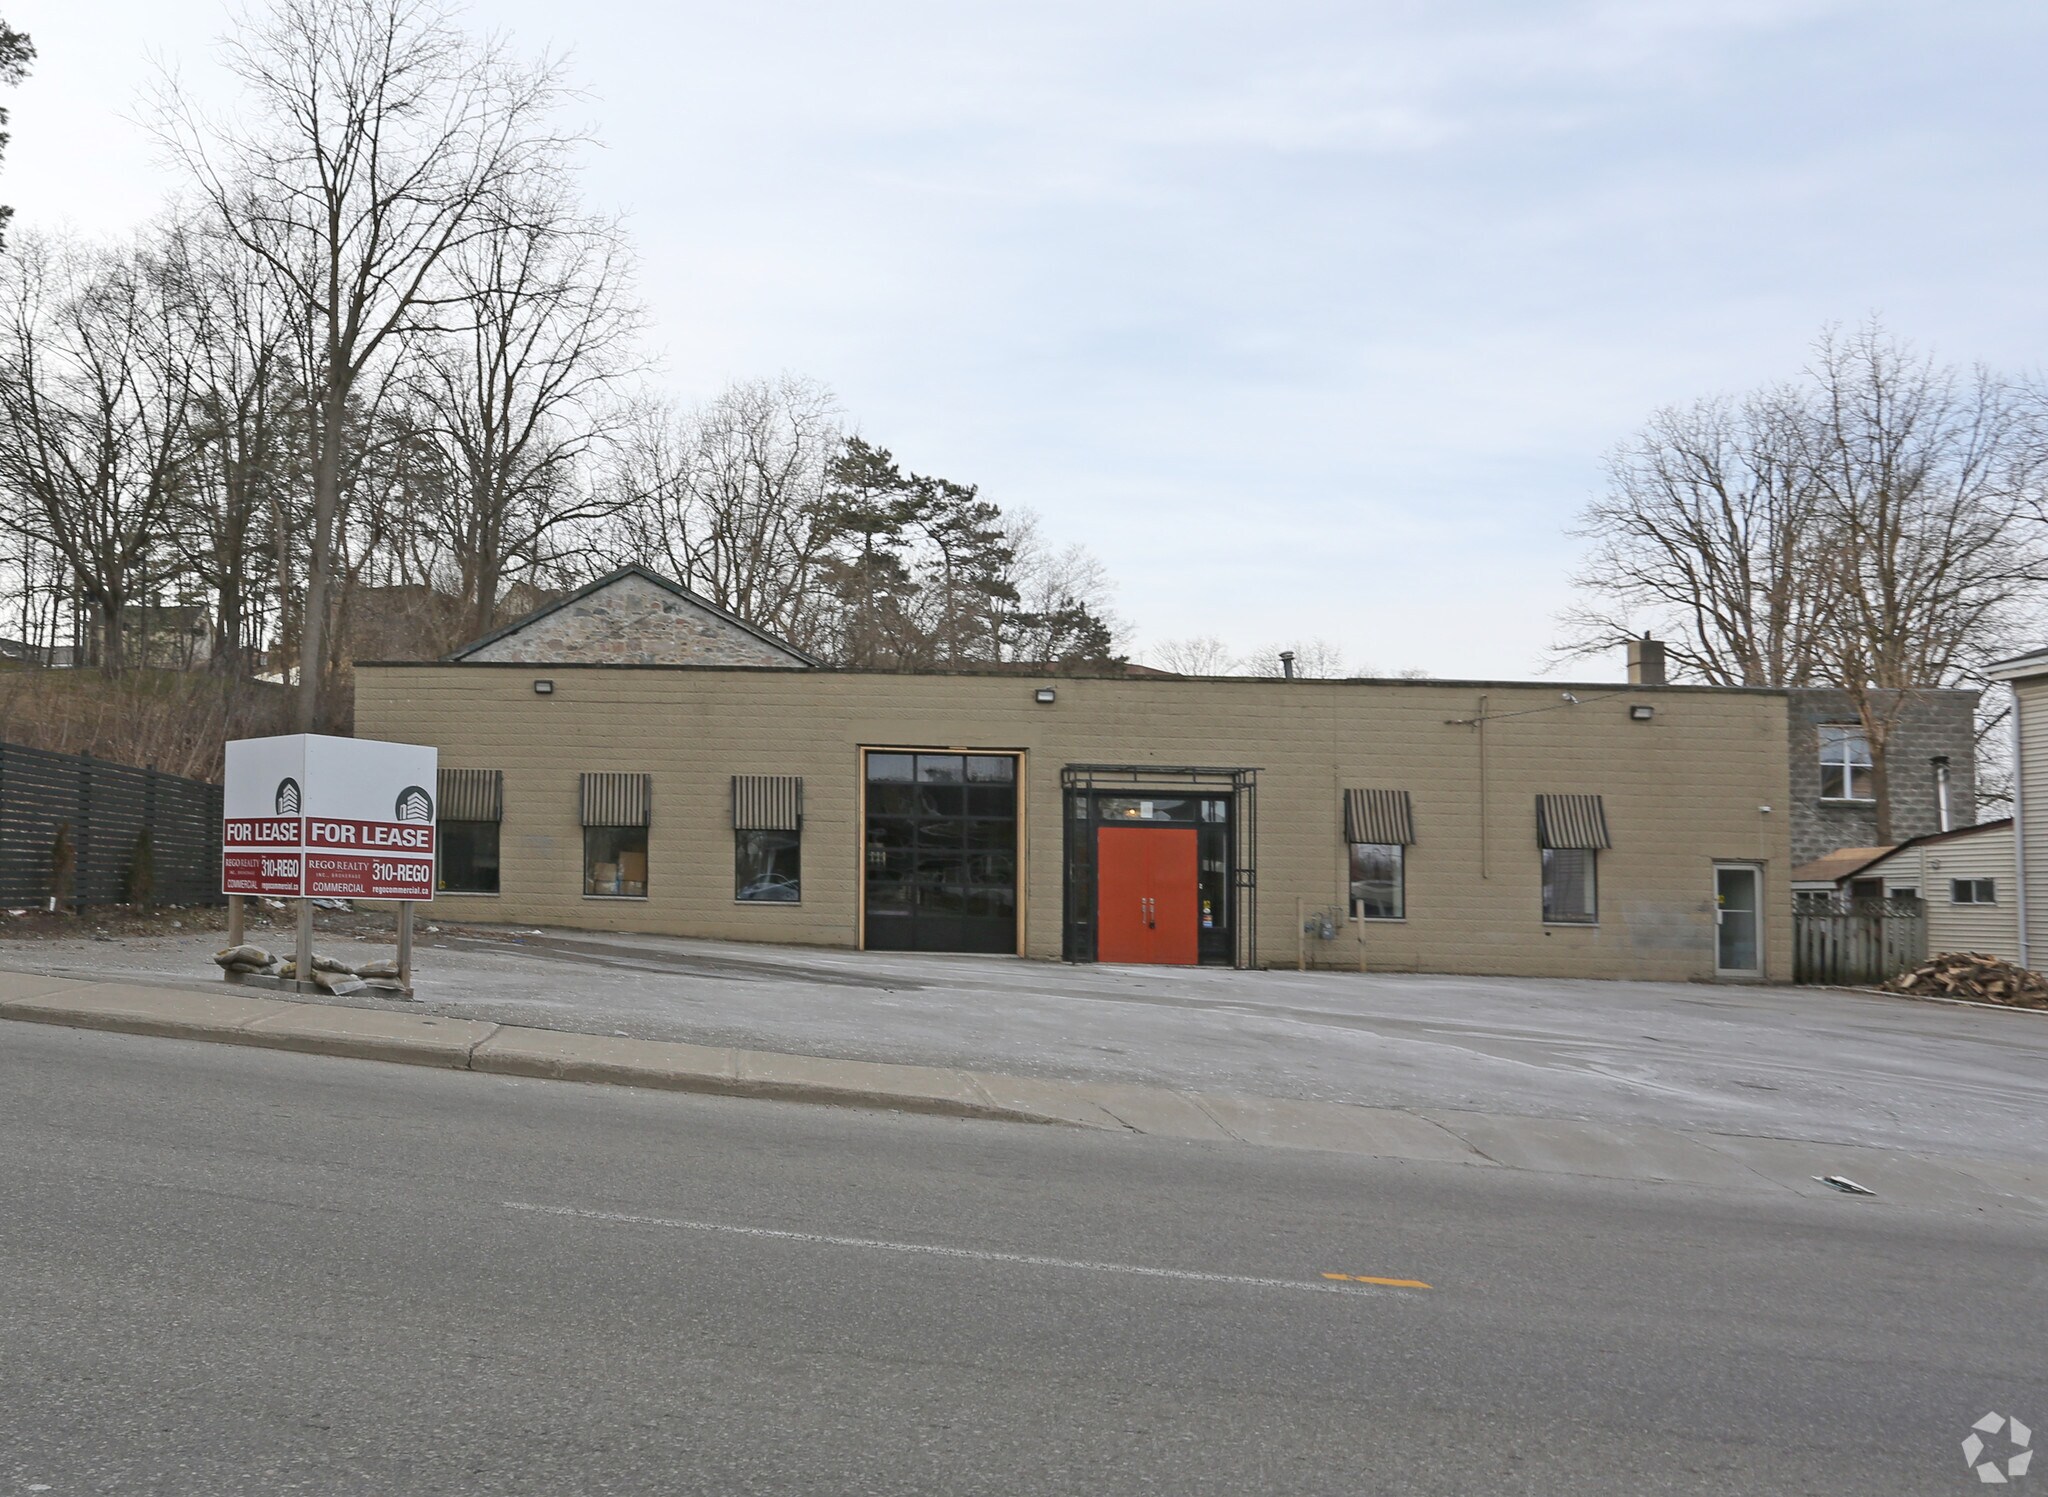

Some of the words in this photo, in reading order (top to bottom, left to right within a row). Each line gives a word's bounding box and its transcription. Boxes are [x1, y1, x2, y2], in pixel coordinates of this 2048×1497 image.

[227, 823, 252, 841] FOR
[255, 822, 298, 841] LEASE
[311, 822, 356, 844] FOR
[362, 826, 429, 848] LEASE
[225, 858, 240, 867] REGO
[241, 859, 259, 868] REALTY
[261, 859, 299, 878] 310-REGO
[308, 859, 336, 870] REGO
[336, 860, 370, 871] REALTY
[372, 862, 430, 883] 310-REGO
[227, 879, 258, 889] COMMERCIAL
[312, 881, 366, 893] COMMERCIAL
[372, 885, 429, 895] regocommercial.ca
